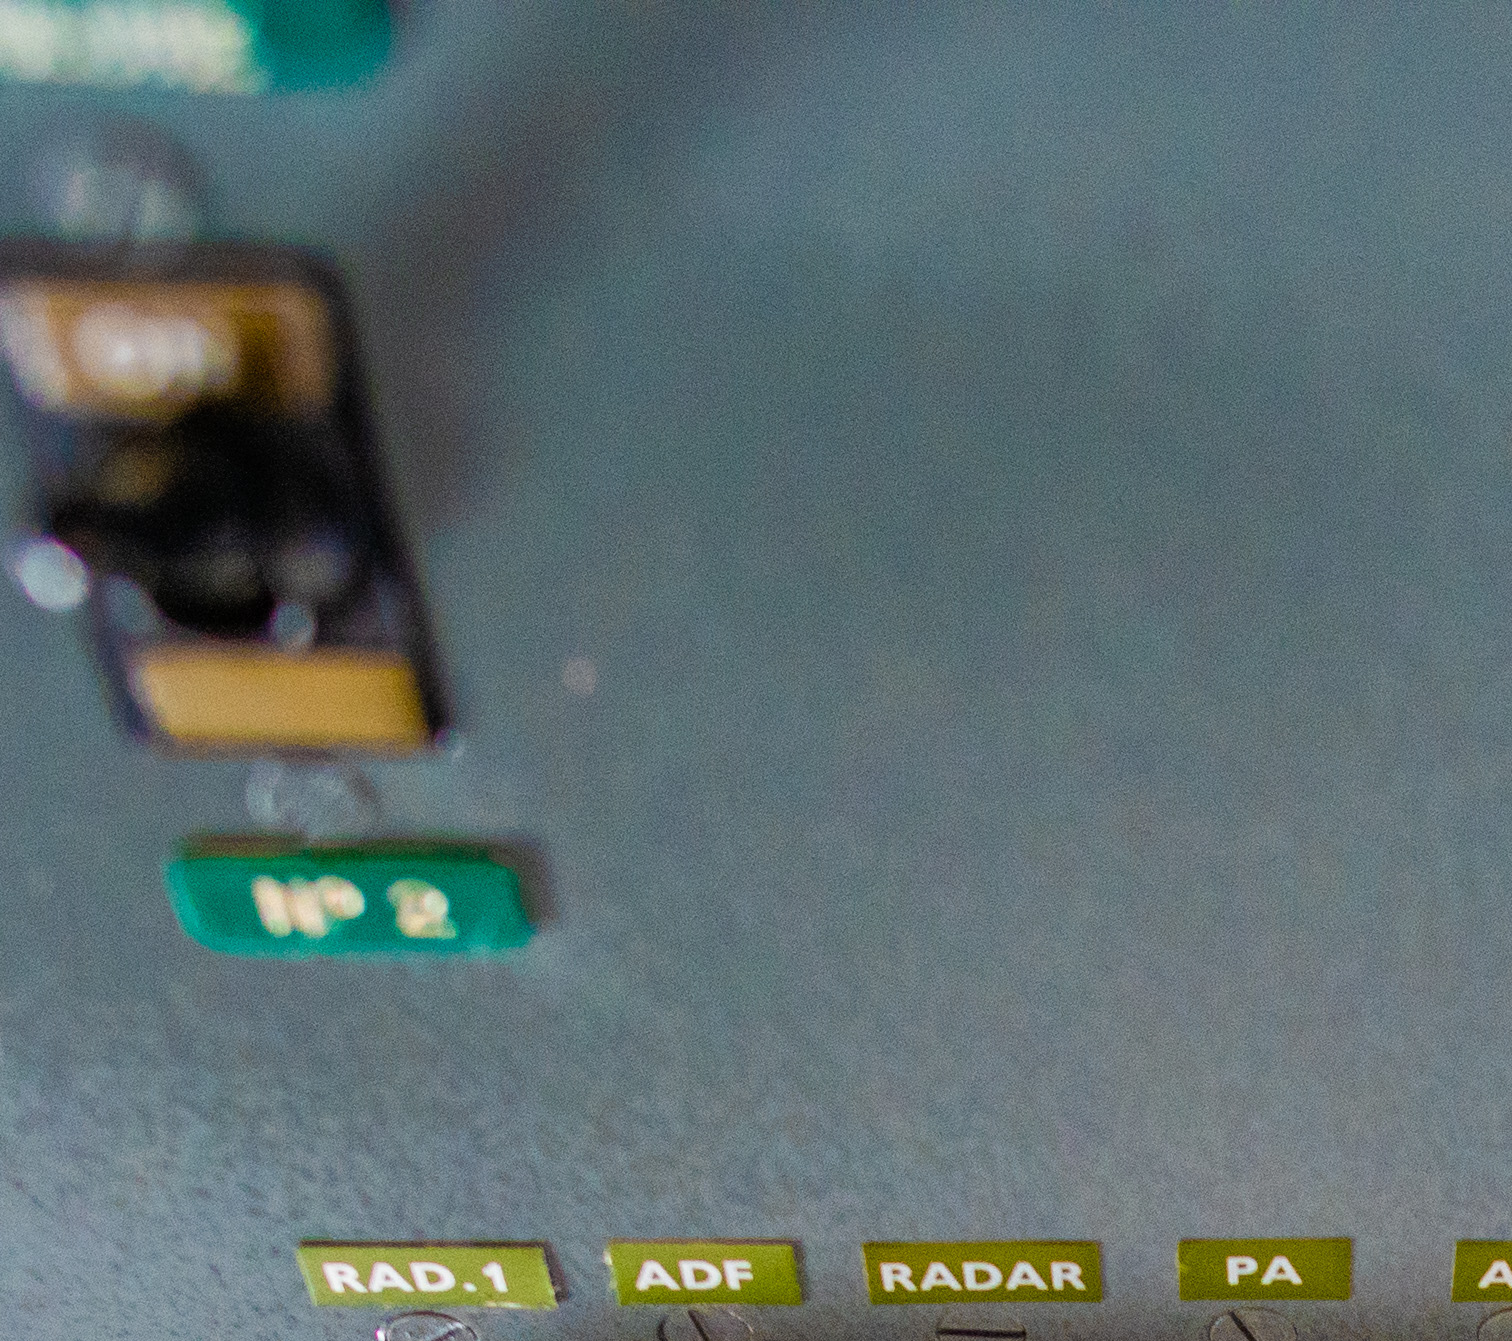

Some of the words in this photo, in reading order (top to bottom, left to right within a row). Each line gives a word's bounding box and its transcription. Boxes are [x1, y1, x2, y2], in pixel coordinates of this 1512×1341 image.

[387, 877, 458, 939] 2
[636, 1258, 755, 1292] ADF
[880, 1260, 1086, 1293] RADAR
[1226, 1255, 1303, 1287] PA
